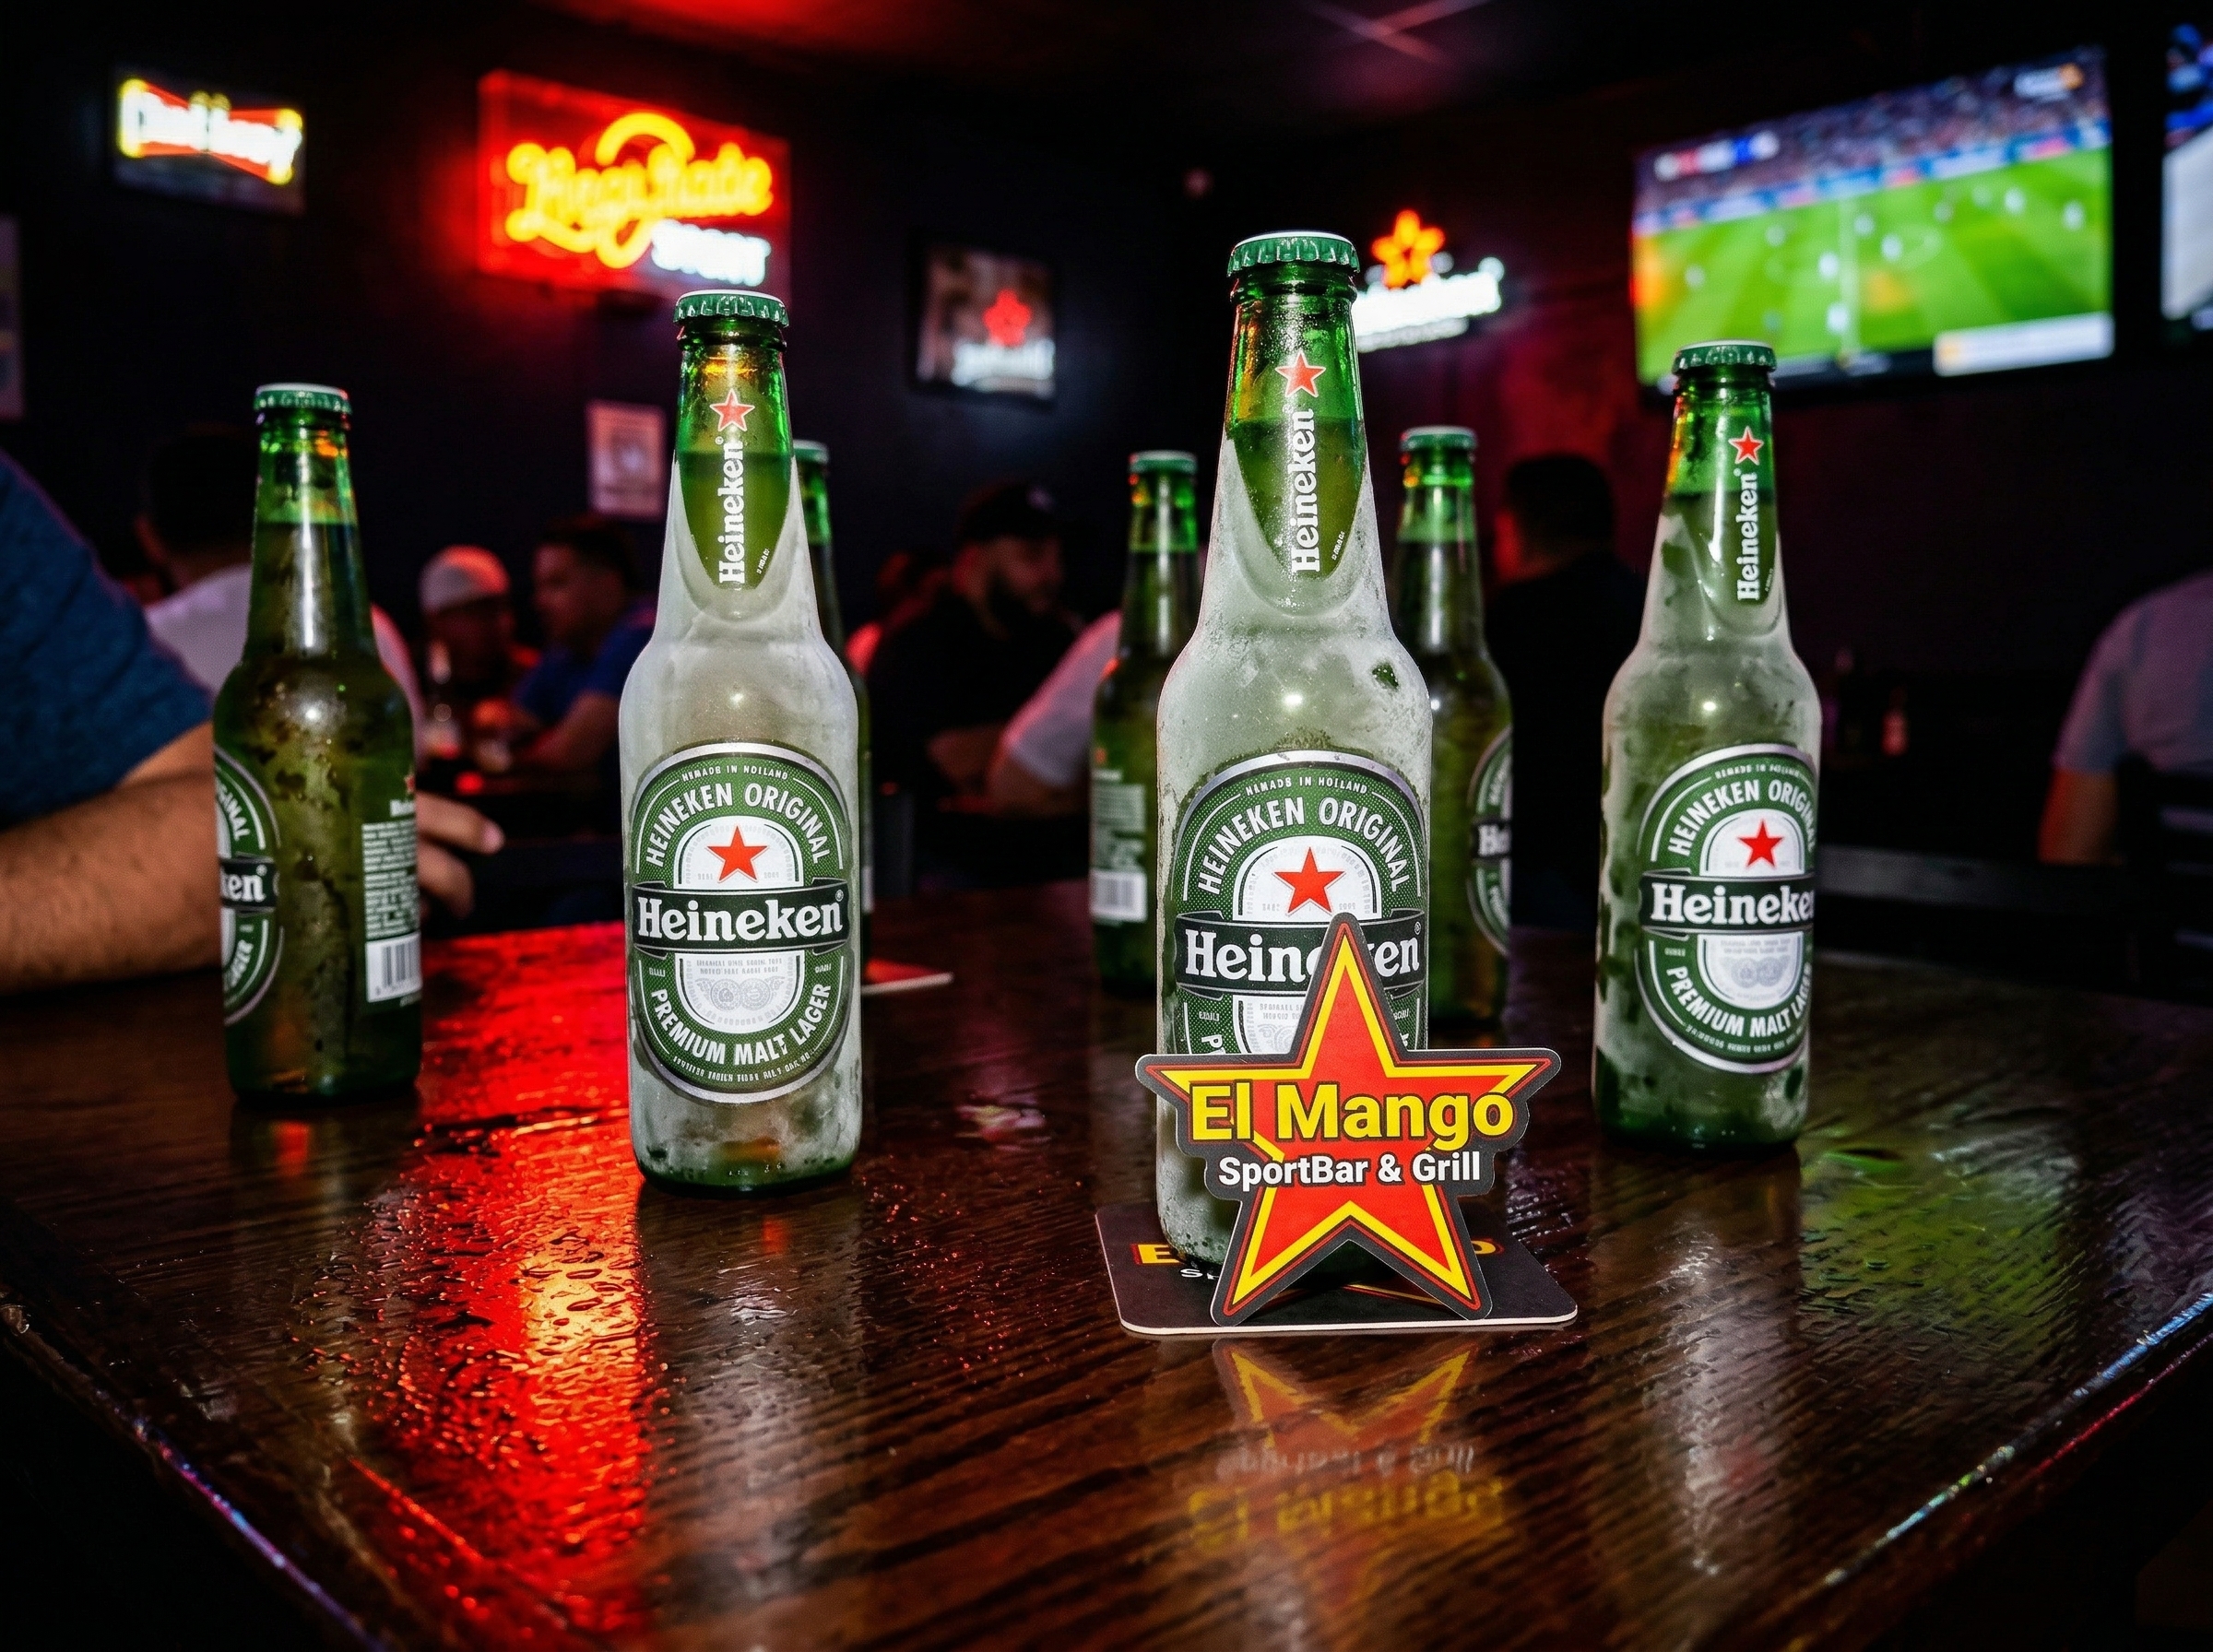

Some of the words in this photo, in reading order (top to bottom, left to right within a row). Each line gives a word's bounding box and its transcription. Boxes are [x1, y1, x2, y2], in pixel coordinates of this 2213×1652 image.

[717, 441, 745, 584] Heineken
[1288, 408, 1320, 572] Heineken
[1735, 472, 1760, 600] Heineken
[727, 765, 738, 773] IN
[1299, 776, 1312, 786] IN
[646, 783, 733, 867] HEINEKEN
[744, 783, 830, 865] ORIGINAL
[1198, 796, 1306, 895] HEINEKEN
[1318, 796, 1412, 892] ORIGINAL
[1667, 779, 1760, 857] HEINEKEN
[637, 896, 843, 941] Heineken
[1185, 928, 1420, 984] Heinen
[651, 988, 726, 1065] PREMIUM
[734, 1035, 788, 1066] MALT
[790, 984, 832, 1046] LAGER
[1666, 966, 1745, 1037] PREMIUM
[1749, 1009, 1792, 1038] MALT
[1190, 1082, 1252, 1140] El
[1276, 1084, 1515, 1151] Mango
[1218, 1155, 1368, 1191] SportBar
[1378, 1154, 1402, 1183] &
[1413, 1151, 1480, 1182] Grill
